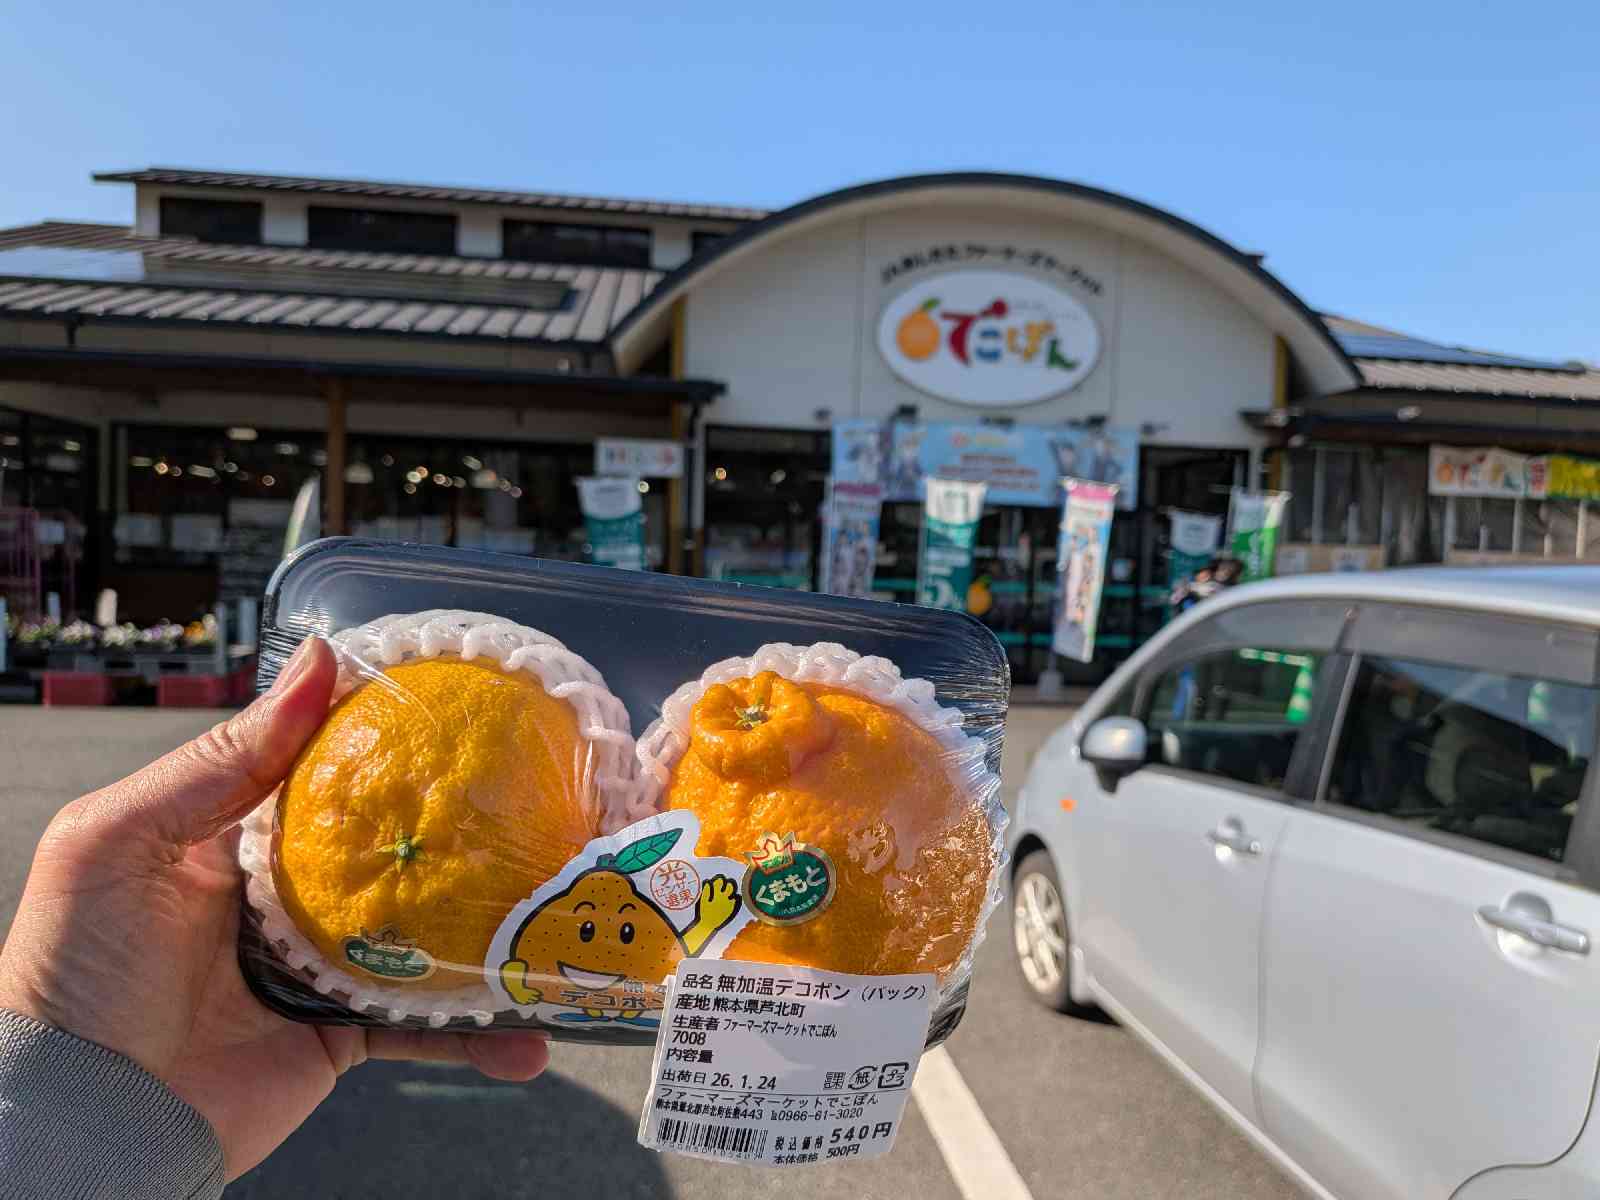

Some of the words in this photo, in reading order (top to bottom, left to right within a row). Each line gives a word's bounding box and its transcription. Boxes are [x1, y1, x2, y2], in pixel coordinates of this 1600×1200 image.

[755, 865, 827, 906] くまもと
[682, 973, 713, 990] 品名
[675, 993, 711, 1011] 産地
[712, 994, 806, 1018] 熊本県芦北町
[672, 1014, 720, 1032] 生産者
[672, 1030, 707, 1046] 7008
[666, 1048, 713, 1064] 内容量
[661, 1068, 707, 1085] 出荷日
[829, 1121, 893, 1144] 540円
[826, 1143, 861, 1159] 500円
